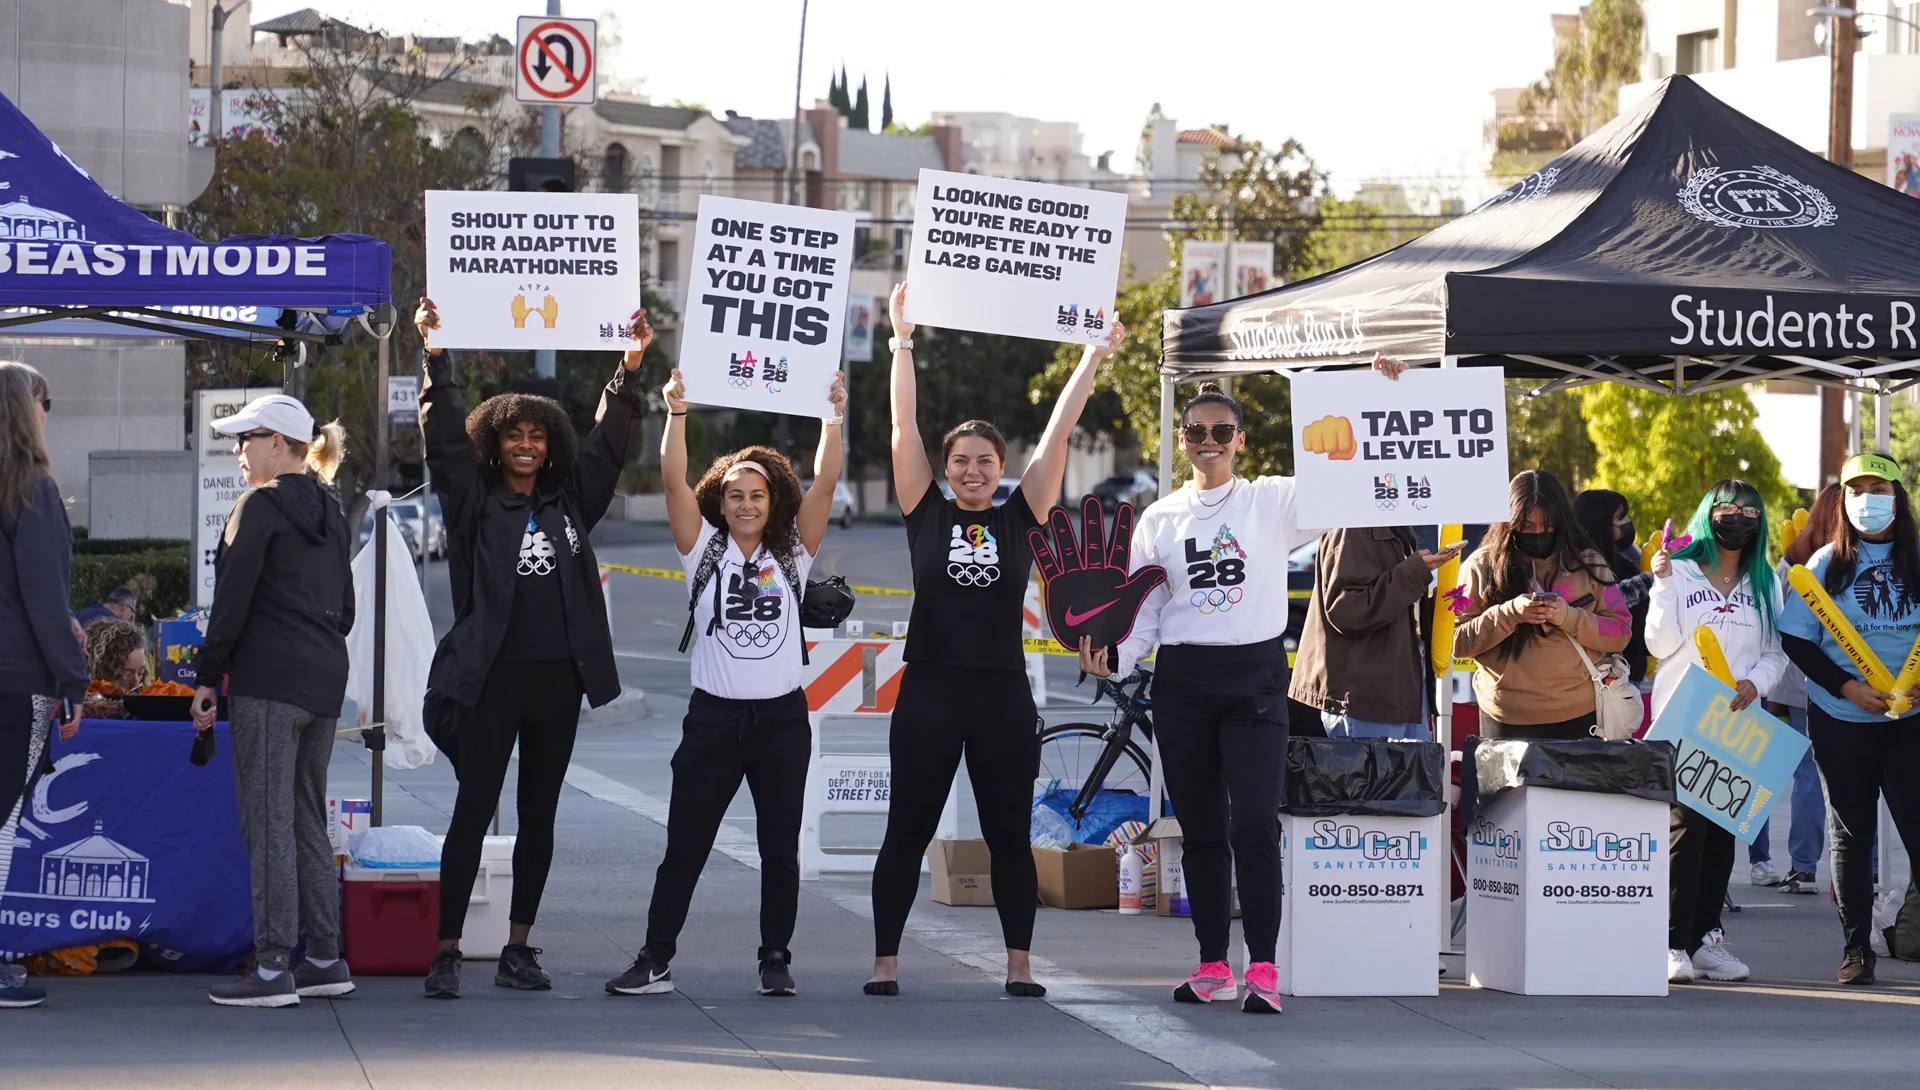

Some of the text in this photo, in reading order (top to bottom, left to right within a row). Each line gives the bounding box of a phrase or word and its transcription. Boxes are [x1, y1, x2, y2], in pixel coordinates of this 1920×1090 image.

[1894, 127, 1920, 138] NOW
[932, 185, 1090, 220] LOOKING GOOD!
[1734, 197, 1791, 213] LA
[451, 212, 615, 231] SHOUT OUT TO
[931, 206, 1113, 245] YOU'RE READY TO
[1722, 212, 1735, 220] IT
[1738, 217, 1760, 226] FOR
[1766, 219, 1788, 227] THE
[711, 217, 839, 249] ONE STEP
[450, 234, 617, 253] OUR ADAPTIVE
[927, 228, 1097, 264] COMPETE IN THE
[449, 257, 618, 276] MARATHONERS
[707, 243, 836, 276] AT A TIME
[924, 249, 1062, 281] LA28 GAMES!
[706, 267, 833, 302] YOU GOT
[1058, 303, 1079, 318] LA
[1084, 307, 1105, 320] LA
[600, 321, 614, 331] LA
[701, 293, 830, 346] THIS
[1056, 315, 1078, 327] 28
[1083, 318, 1104, 330] 28
[1670, 293, 1918, 350] Students R
[600, 330, 614, 338] 28
[730, 350, 758, 368] LA
[728, 364, 755, 379] 28
[762, 368, 788, 383] 28
[391, 390, 415, 402] 431
[213, 403, 244, 419] CEN
[1361, 408, 1493, 437] TAP TO
[1363, 438, 1494, 461] LEVEL UP
[203, 476, 235, 489] DANIEL
[215, 491, 246, 501] 310.80
[1374, 487, 1399, 500] 28
[1407, 486, 1432, 499] 28
[206, 513, 229, 527] STEV
[519, 531, 556, 558] 28
[948, 537, 999, 565] 28
[1184, 522, 1247, 564] LA
[1187, 558, 1246, 589] 28
[726, 595, 782, 621] 28
[1698, 612, 1755, 630] Califrnia
[1864, 622, 1869, 631] it
[1870, 622, 1881, 631] for
[1882, 623, 1895, 631] the
[1816, 607, 1847, 642] RUNNING
[1844, 642, 1864, 665] THEM
[1861, 664, 1874, 677] IN!
[177, 668, 198, 678] Clas
[1697, 693, 1770, 763] Run
[828, 778, 889, 788] DEPT. OF PUBL
[840, 770, 856, 778] CITY
[858, 770, 867, 778] OF
[869, 771, 884, 779] LOS
[827, 788, 891, 801] STREET SE
[328, 809, 336, 839] ULTRA
[1313, 819, 1421, 861] SoCal
[1547, 820, 1651, 862] SoCal
[1313, 861, 1420, 869] SANITATION
[1475, 856, 1518, 869] SANITATION
[1547, 863, 1650, 871] SANITATION
[1308, 884, 1425, 897] 800-850-8871
[1473, 877, 1519, 896] 800-850-8871
[1542, 885, 1654, 898] 800-850-8871
[0, 909, 132, 931] ners Club
